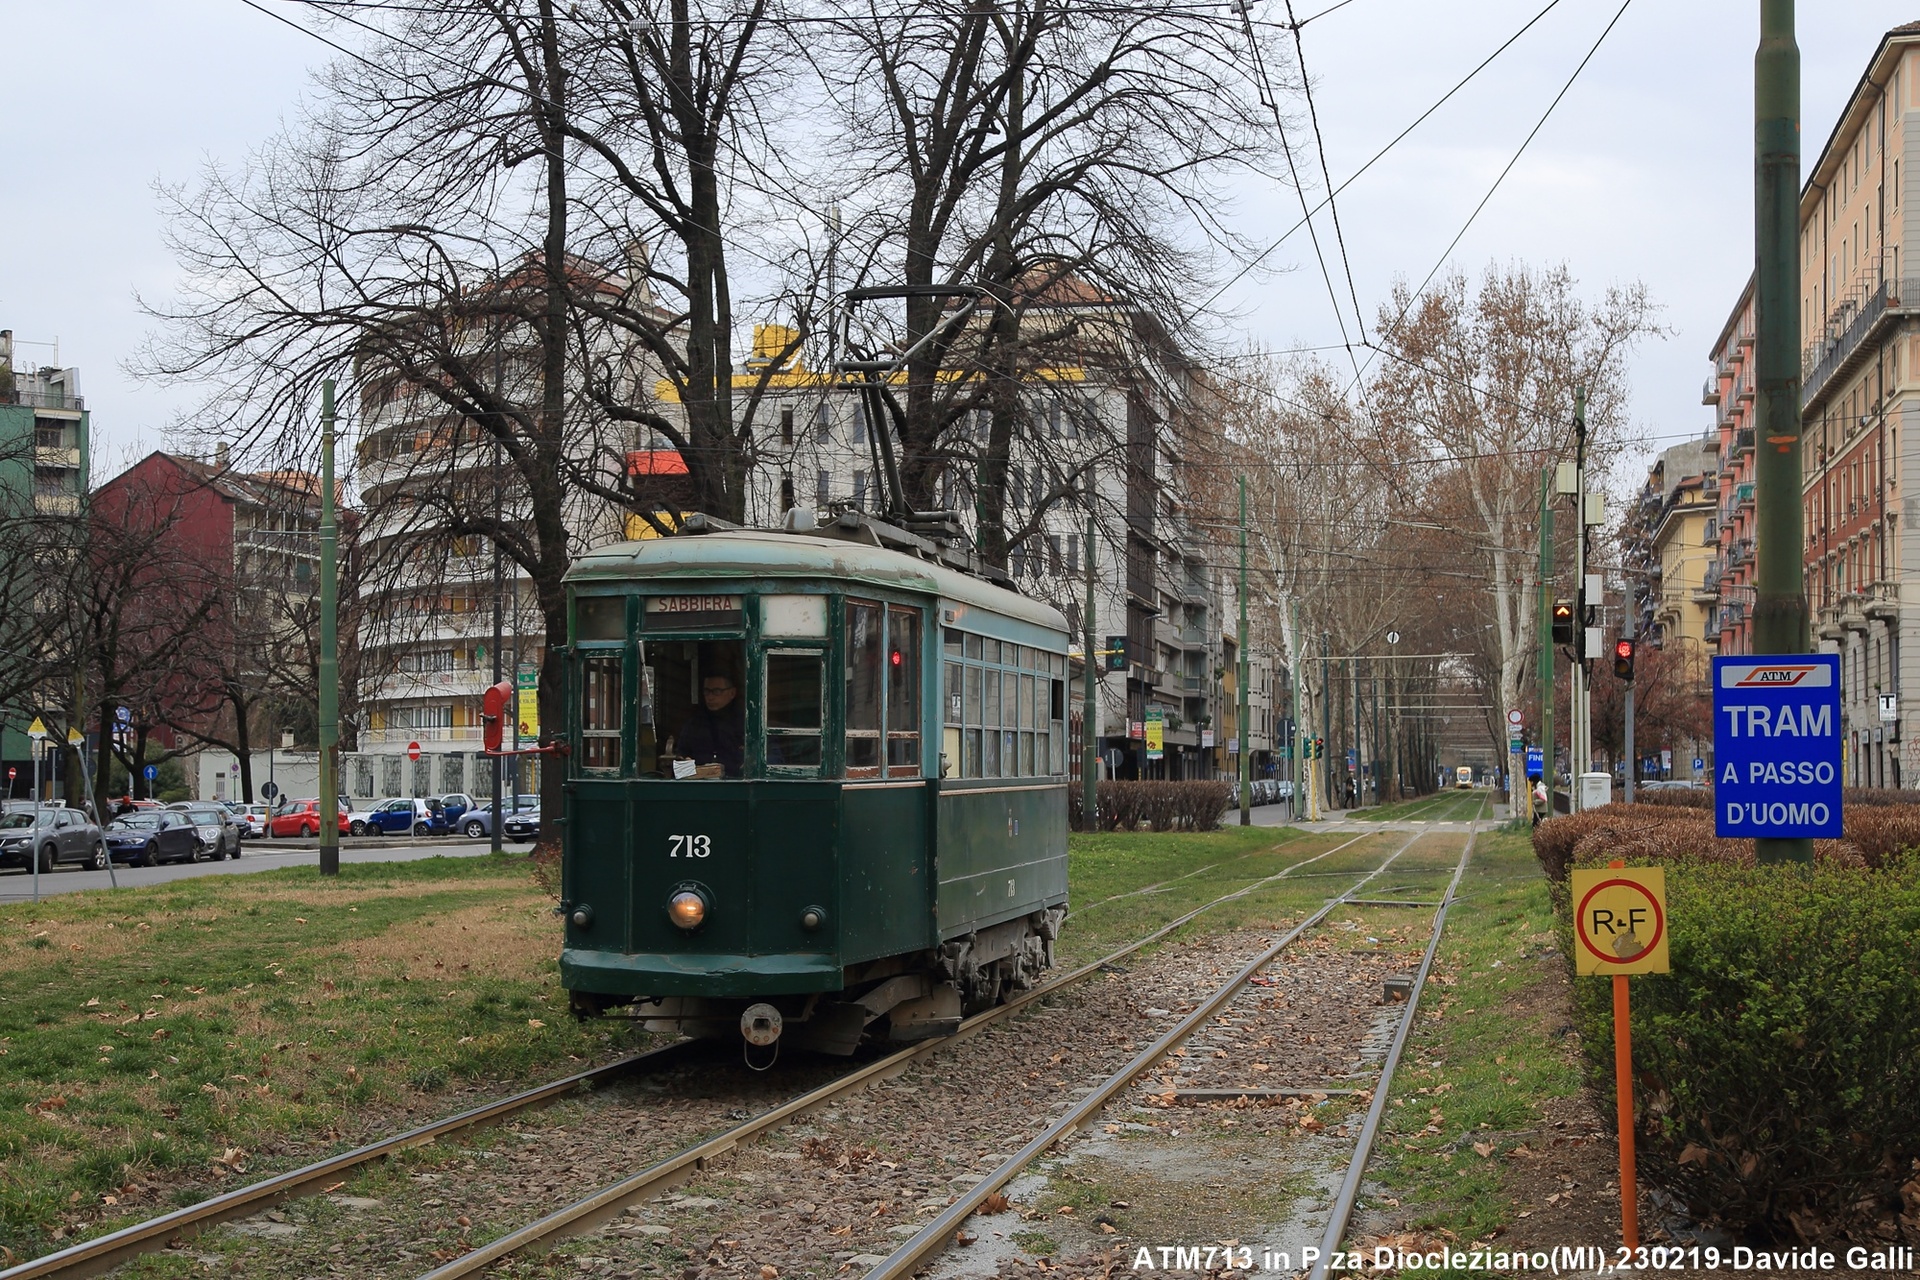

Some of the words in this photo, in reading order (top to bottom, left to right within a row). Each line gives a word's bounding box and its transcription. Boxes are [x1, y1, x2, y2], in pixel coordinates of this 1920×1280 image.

[658, 596, 733, 612] SABBIERA
[1760, 671, 1793, 682] ATM
[1722, 704, 1832, 738] TRAM
[1694, 759, 1702, 769] P
[1721, 762, 1739, 784] A
[1750, 761, 1835, 785] PASSO
[1727, 802, 1830, 826] D'UOMO
[668, 834, 711, 858] 713
[1007, 878, 1016, 898] 713
